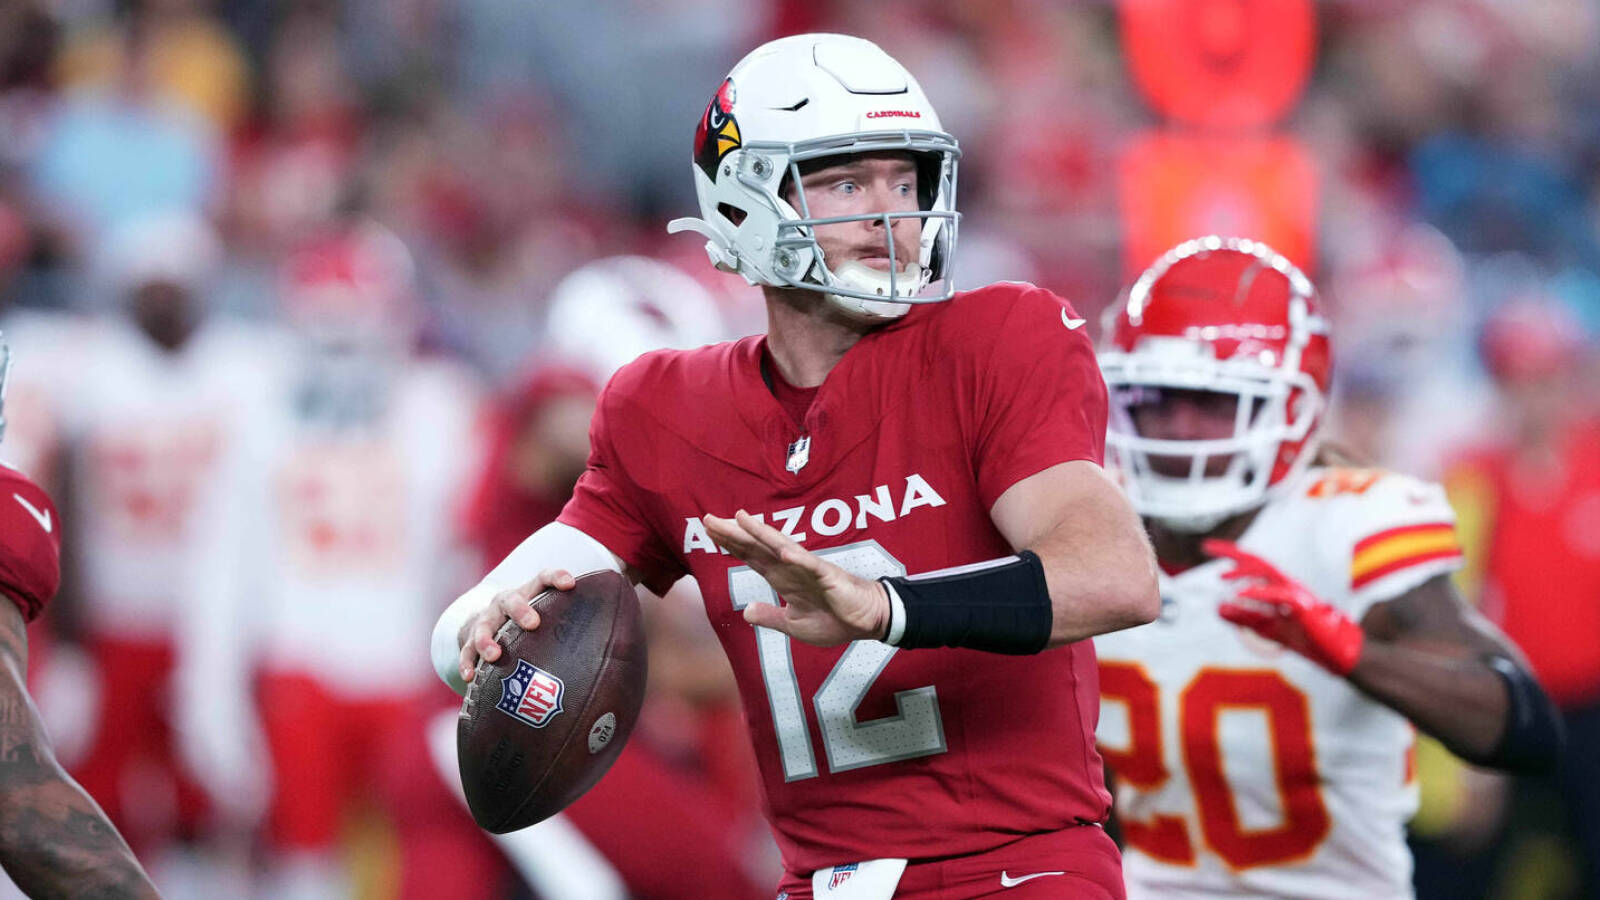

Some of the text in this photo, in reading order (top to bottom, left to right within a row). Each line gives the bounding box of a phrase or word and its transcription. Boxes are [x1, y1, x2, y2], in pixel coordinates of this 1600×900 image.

[683, 473, 947, 556] AZONA
[518, 678, 557, 722] NFL
[728, 538, 948, 783] 12
[1096, 658, 1333, 874] 20
[831, 871, 852, 888] NF
